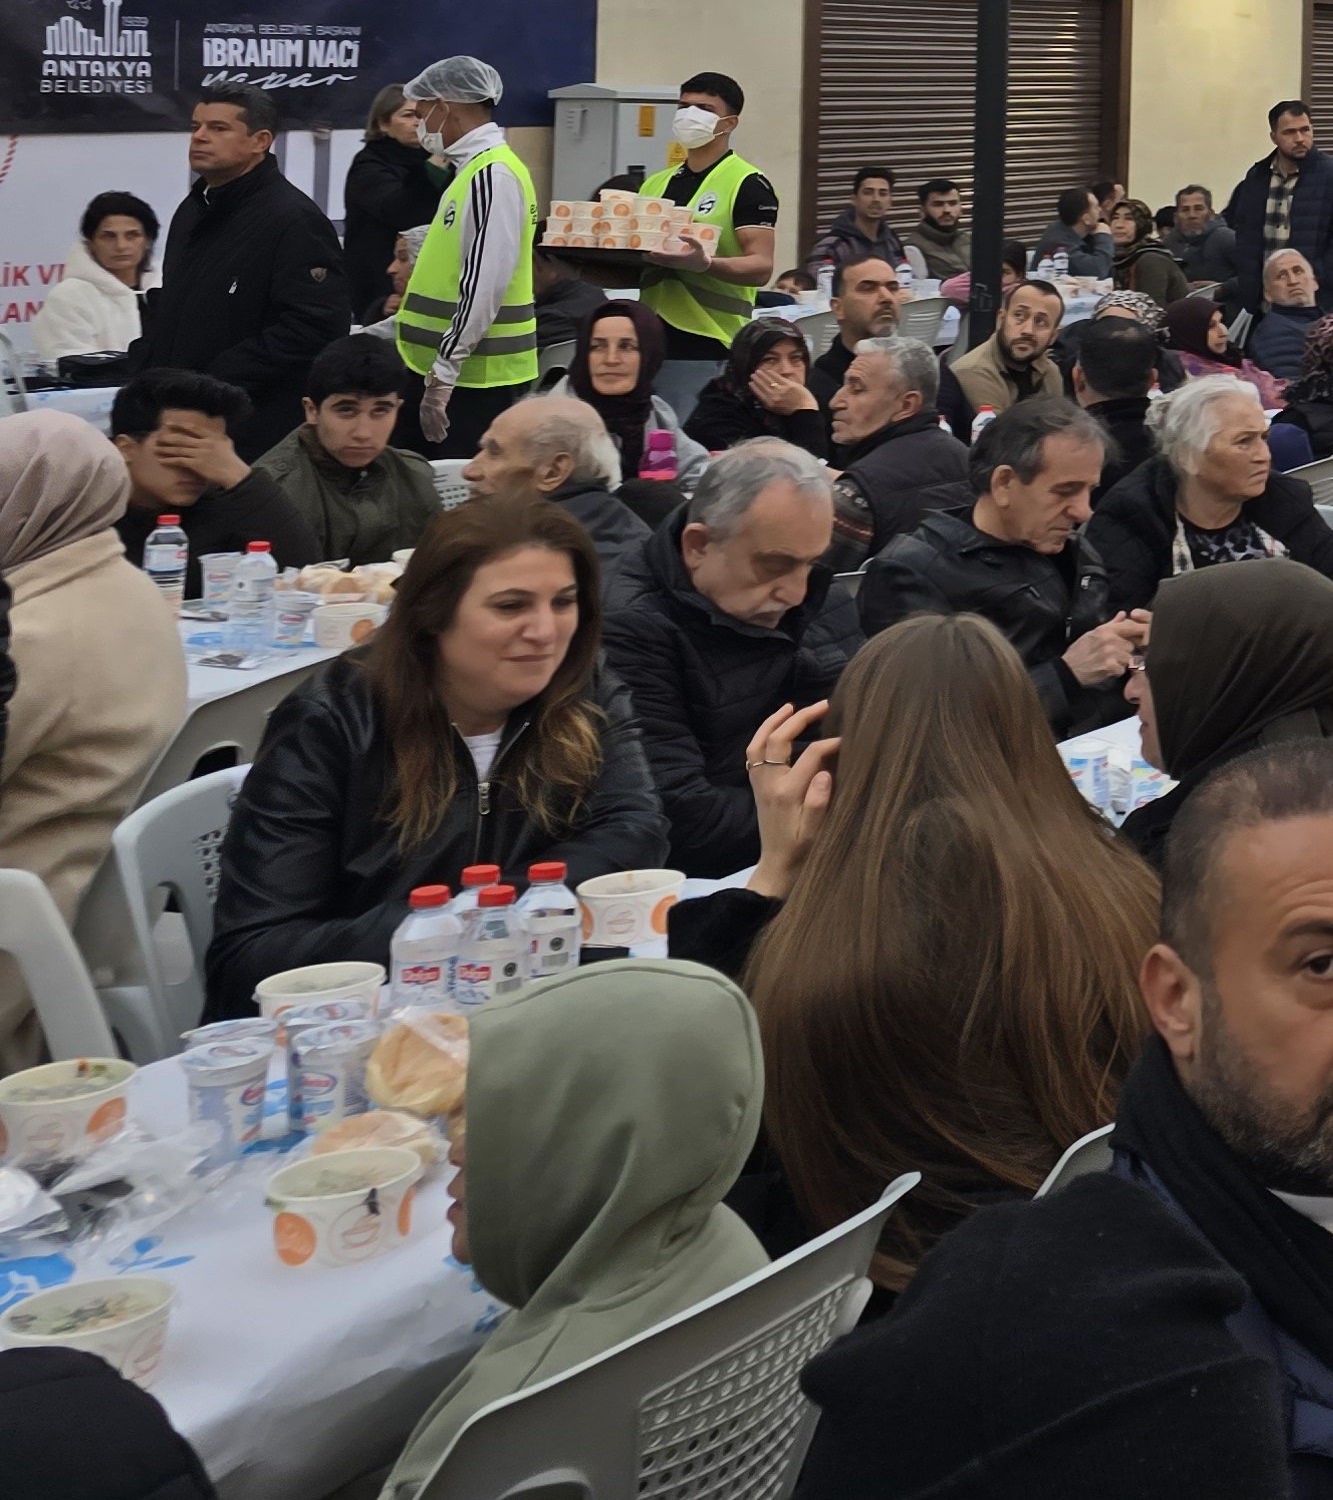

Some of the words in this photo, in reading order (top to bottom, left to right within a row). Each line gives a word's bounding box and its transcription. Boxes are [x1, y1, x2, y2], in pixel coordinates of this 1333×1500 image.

[203, 37, 304, 67] İBRAHİM
[308, 39, 361, 68] NACİ
[42, 60, 152, 77] ANTAKYA
[40, 79, 153, 94] BELEDİYESİ
[0, 261, 30, 287] İK
